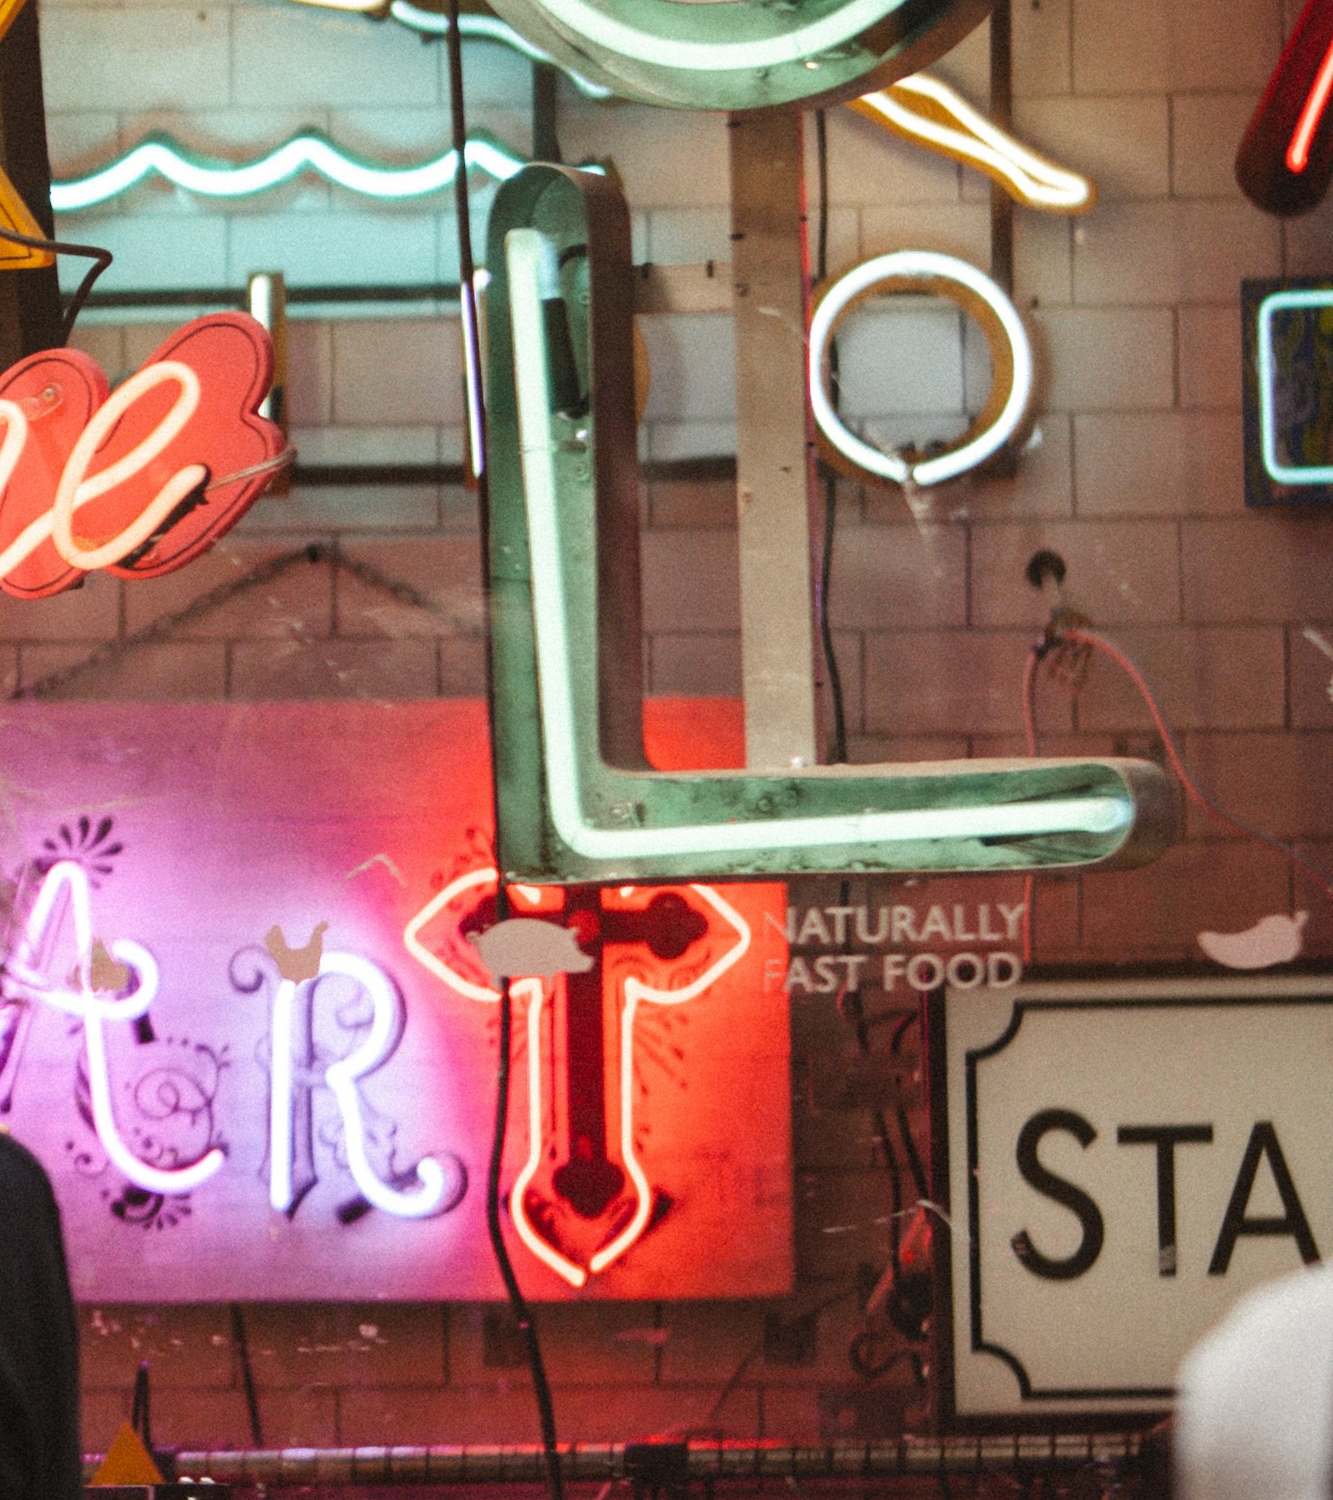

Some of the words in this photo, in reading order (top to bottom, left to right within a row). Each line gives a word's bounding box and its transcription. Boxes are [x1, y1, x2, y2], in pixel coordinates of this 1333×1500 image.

[763, 902, 1025, 945] NATURALLY
[763, 953, 868, 994] FAST
[883, 951, 1023, 992] FOOD
[1011, 1107, 1325, 1282] STA
